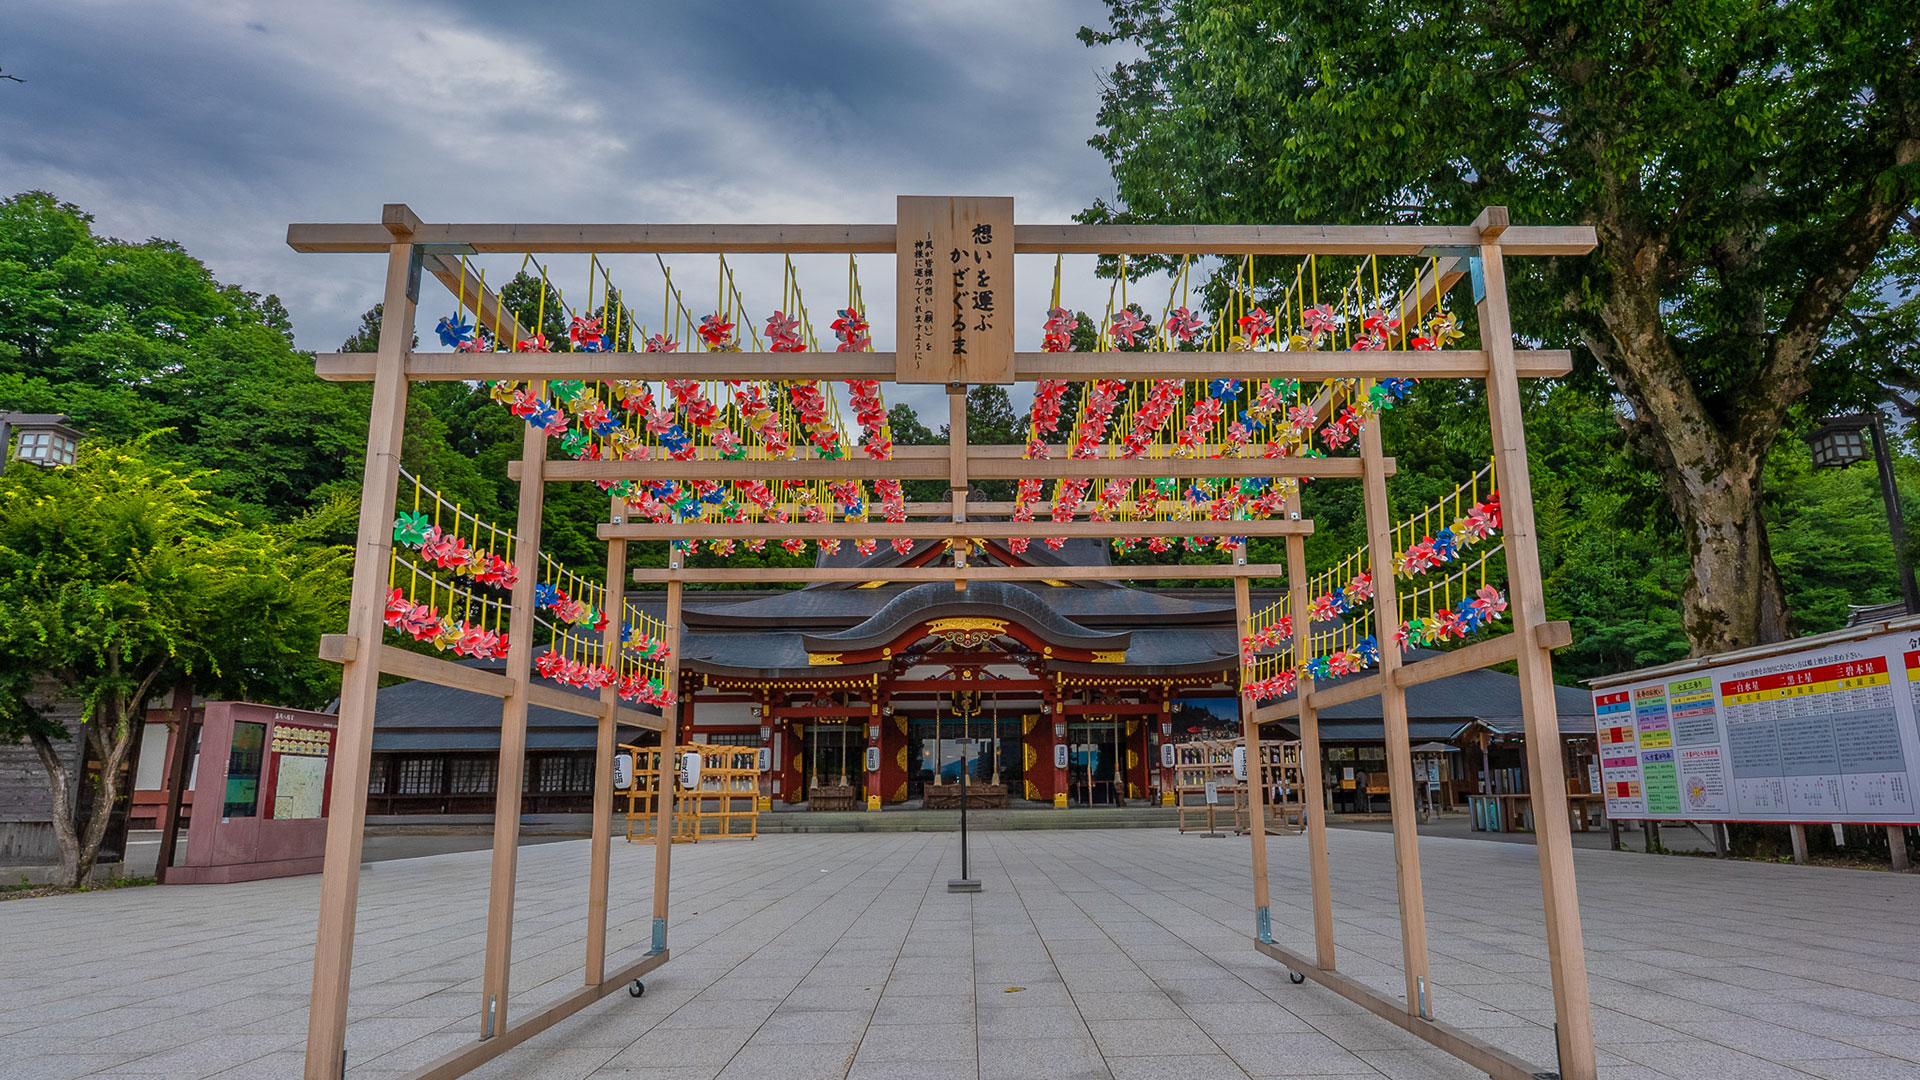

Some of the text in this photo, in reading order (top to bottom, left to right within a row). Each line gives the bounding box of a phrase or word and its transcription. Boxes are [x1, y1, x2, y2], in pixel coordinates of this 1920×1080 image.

[950, 247, 971, 355] かざぐるま
[971, 223, 995, 332] 想いを運ぶ
